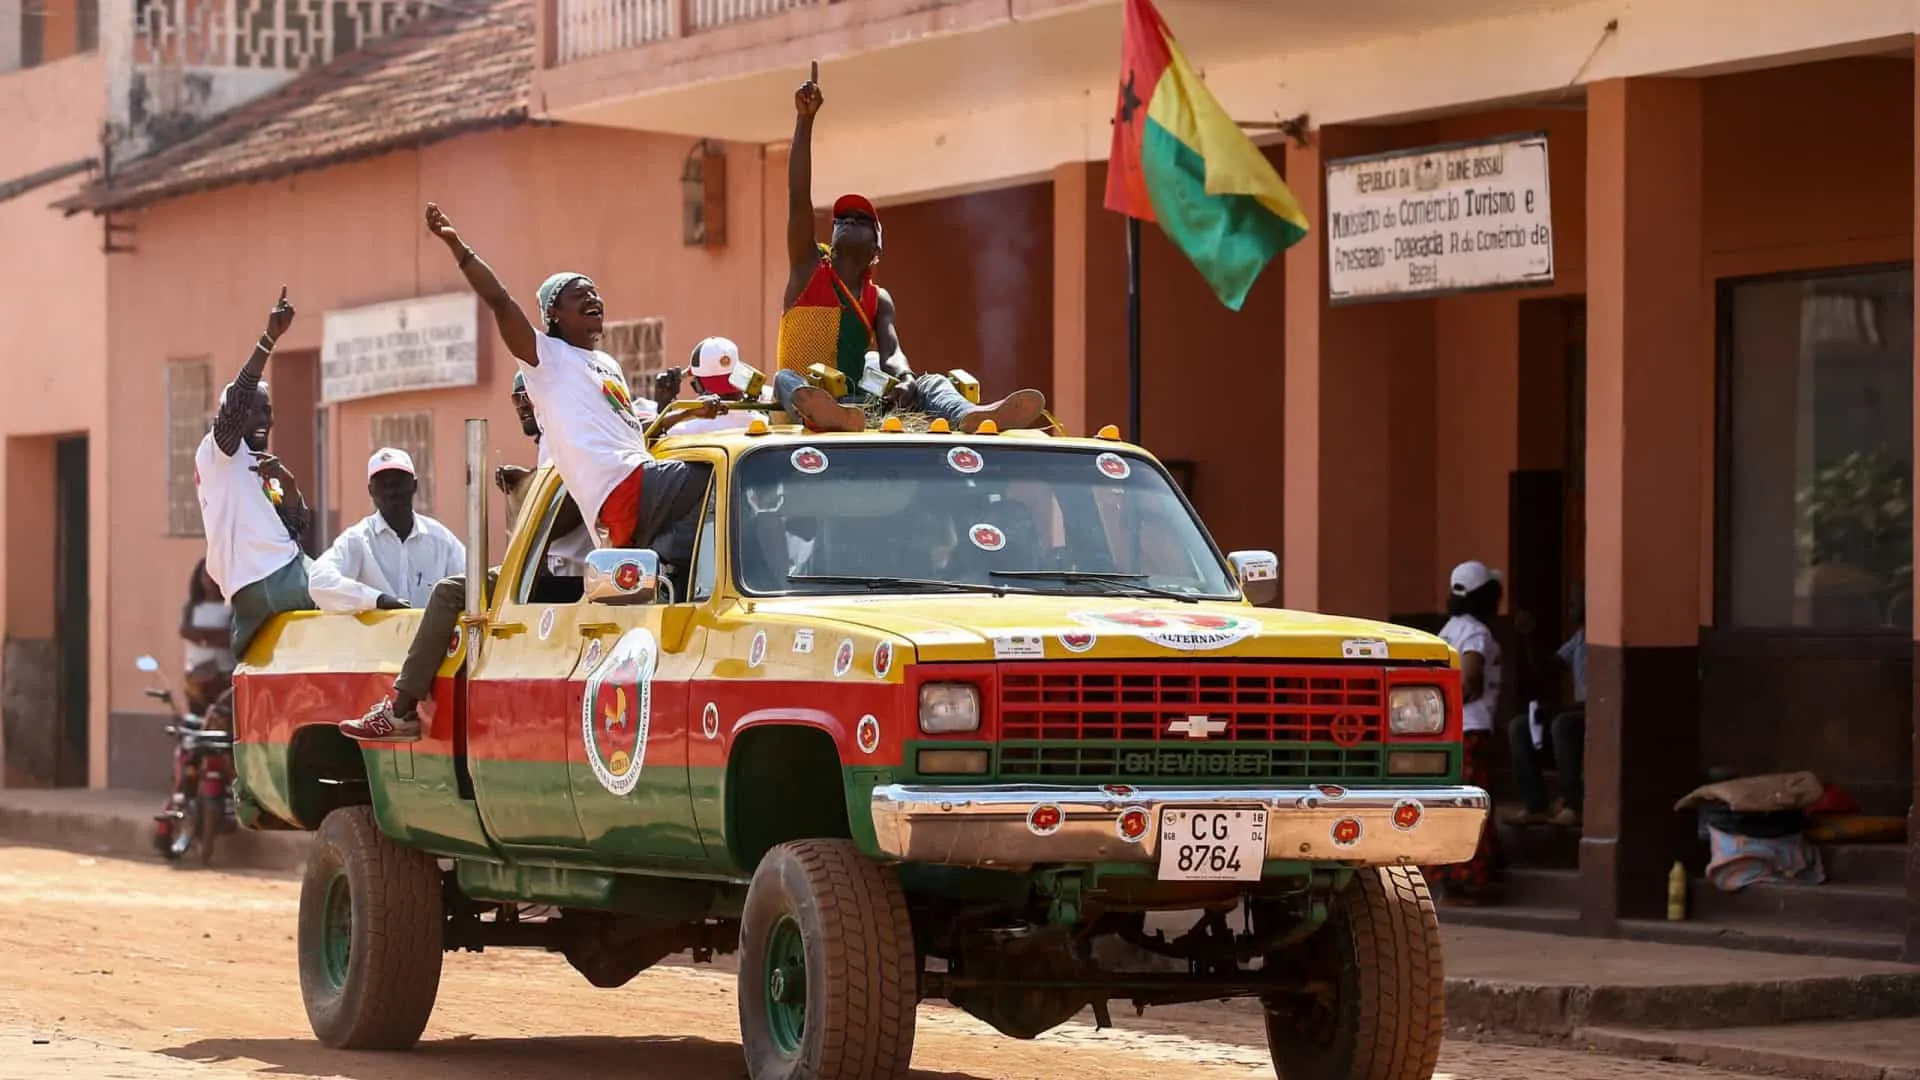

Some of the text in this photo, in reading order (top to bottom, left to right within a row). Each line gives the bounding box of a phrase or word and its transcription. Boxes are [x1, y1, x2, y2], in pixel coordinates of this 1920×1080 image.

[1399, 167, 1410, 188] DA
[1473, 155, 1504, 179] BISSAU
[1382, 206, 1396, 229] do
[1464, 186, 1516, 217] Turismo
[1525, 189, 1535, 214] e
[1461, 230, 1474, 253] do
[1530, 223, 1549, 246] de
[1125, 753, 1268, 774] CHEVROLET
[1191, 813, 1229, 841] CG
[1251, 831, 1263, 841] 04
[1177, 844, 1242, 873] 8764
